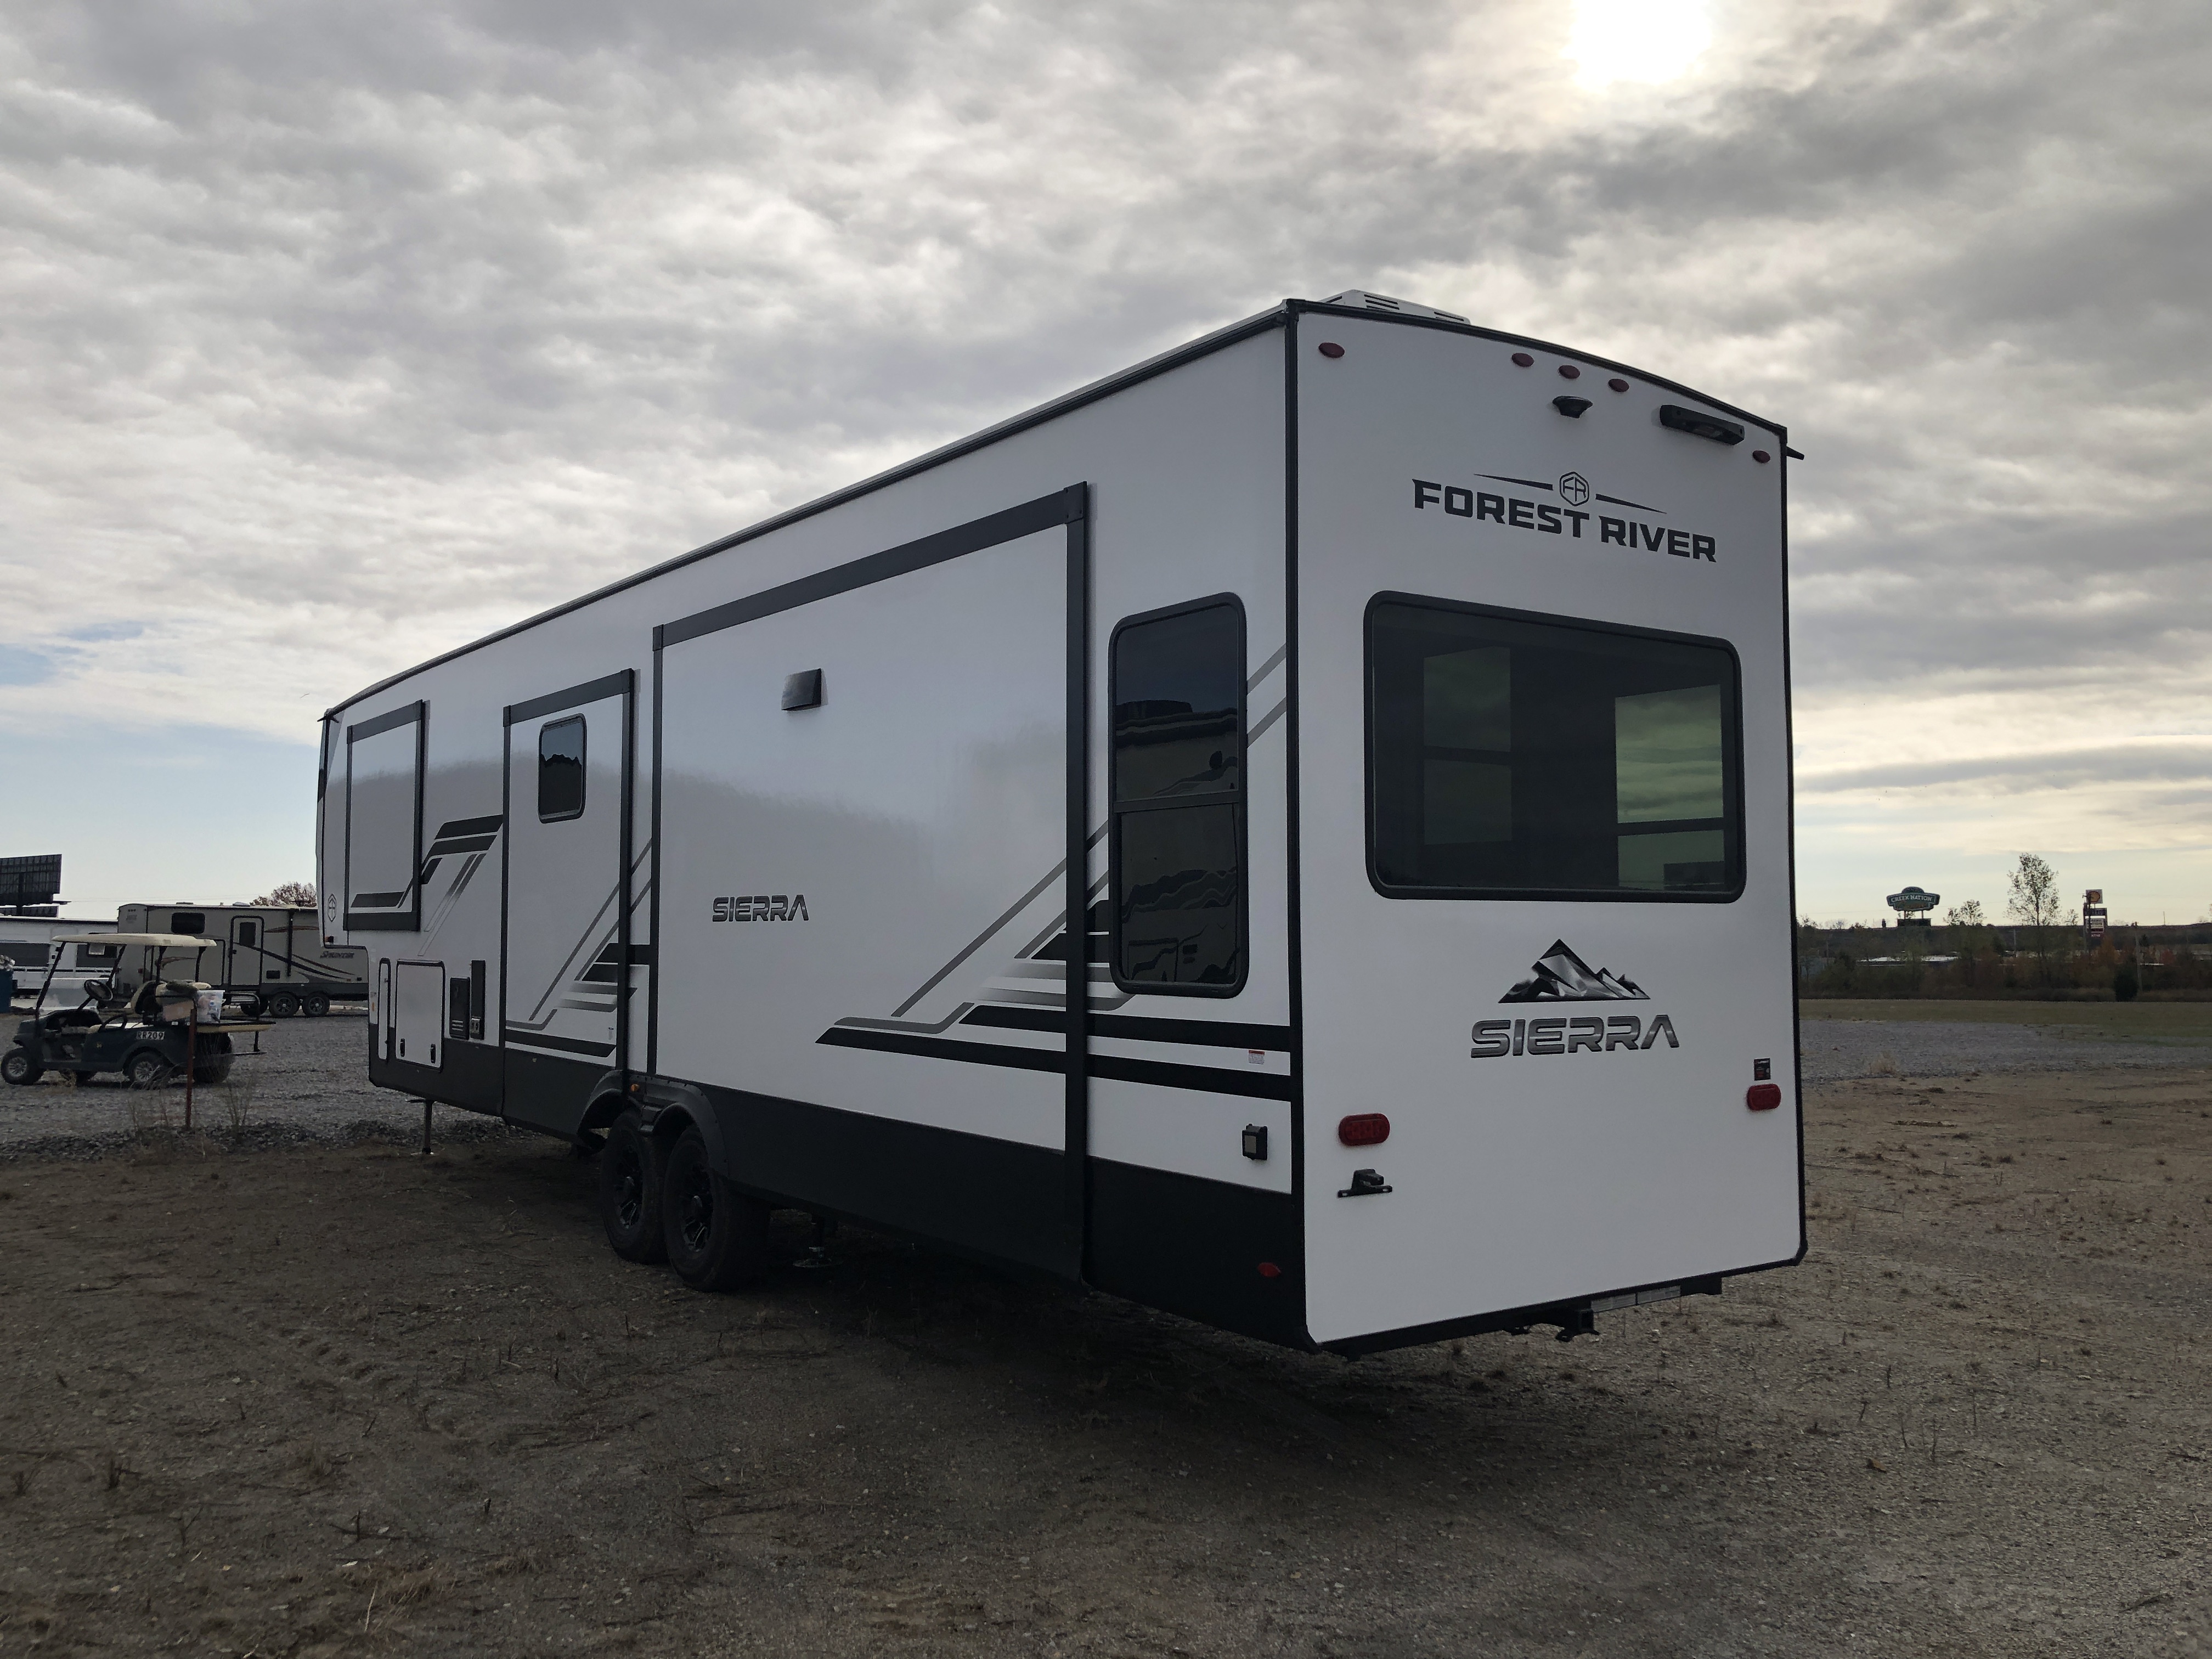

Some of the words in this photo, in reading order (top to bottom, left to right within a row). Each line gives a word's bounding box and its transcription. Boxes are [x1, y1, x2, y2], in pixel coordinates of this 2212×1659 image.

[1412, 478, 1590, 538] FOREST
[1598, 515, 1717, 563] RIVER
[713, 894, 809, 922] SIERRA
[1471, 1014, 1680, 1058] SIERRA
